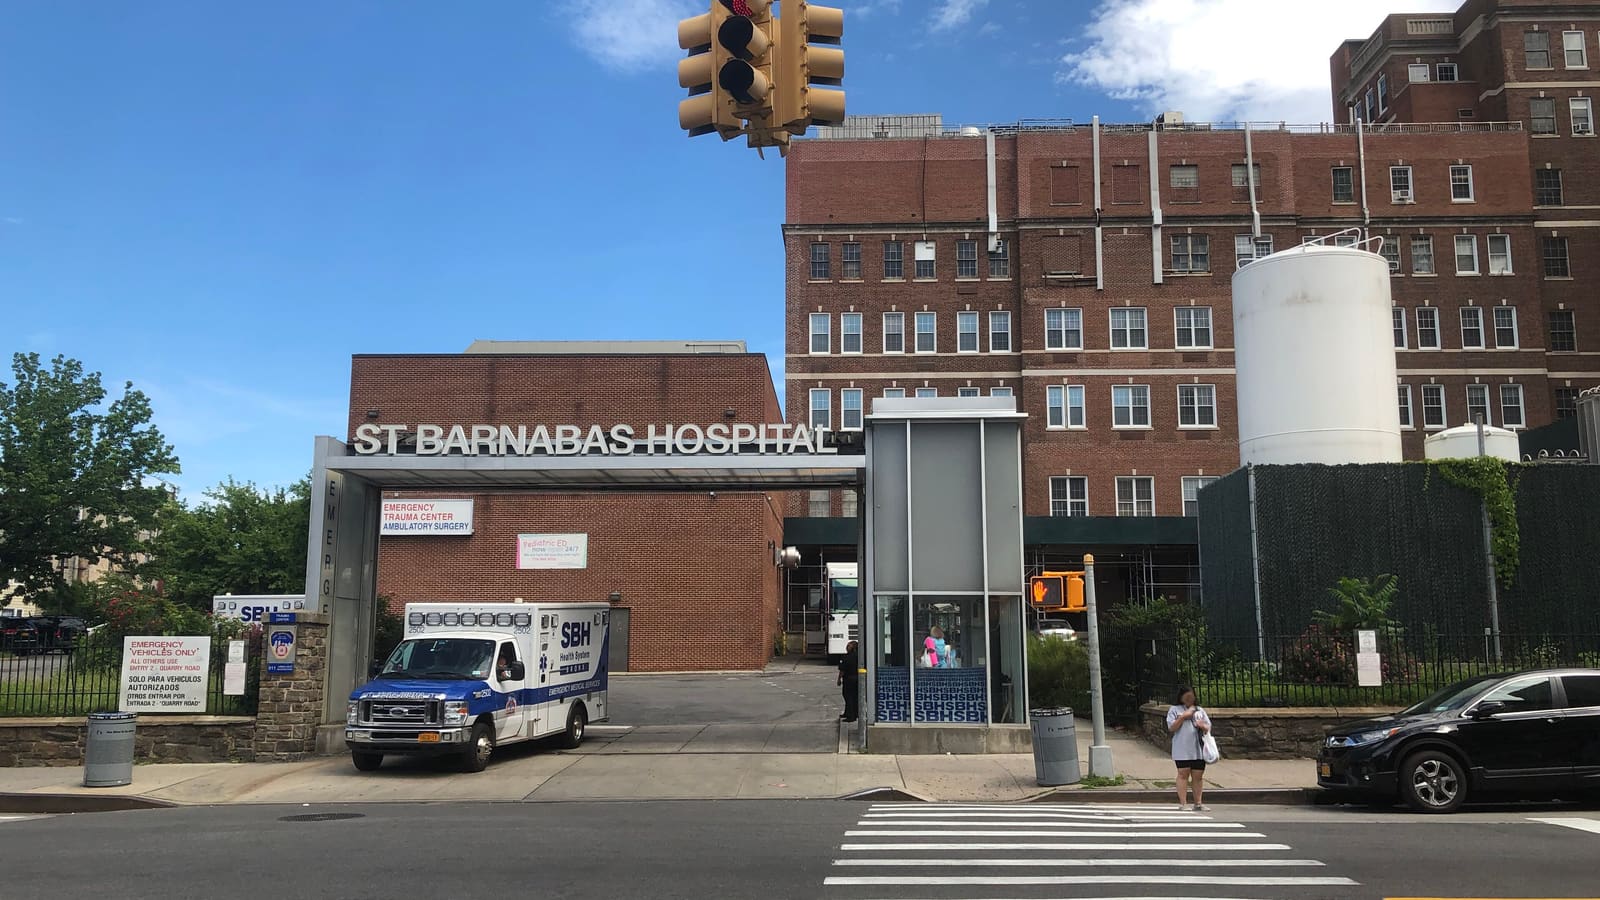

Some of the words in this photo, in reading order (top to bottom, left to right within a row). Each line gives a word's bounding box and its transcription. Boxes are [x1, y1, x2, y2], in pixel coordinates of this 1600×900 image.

[354, 423, 407, 456] ST
[415, 424, 635, 456] BARNABAS
[647, 423, 838, 456] HOSPITAL
[383, 503, 435, 512] EMERGENCY
[384, 513, 418, 521] TRAUMA
[420, 513, 454, 521] CENTER
[383, 522, 433, 531] AMBULATORY
[434, 522, 469, 530] SURGERY
[408, 626, 425, 634] 2502
[513, 627, 531, 635] 2502
[561, 621, 591, 649] SBH
[560, 652, 574, 661] Health
[575, 651, 590, 661] System
[128, 675, 146, 683] SOLO
[148, 675, 165, 683] PARA
[167, 675, 202, 683] VEHICULOS
[549, 684, 570, 697] EMERGENCY
[571, 682, 585, 692] MEDICAL
[585, 679, 600, 689] SERVICES
